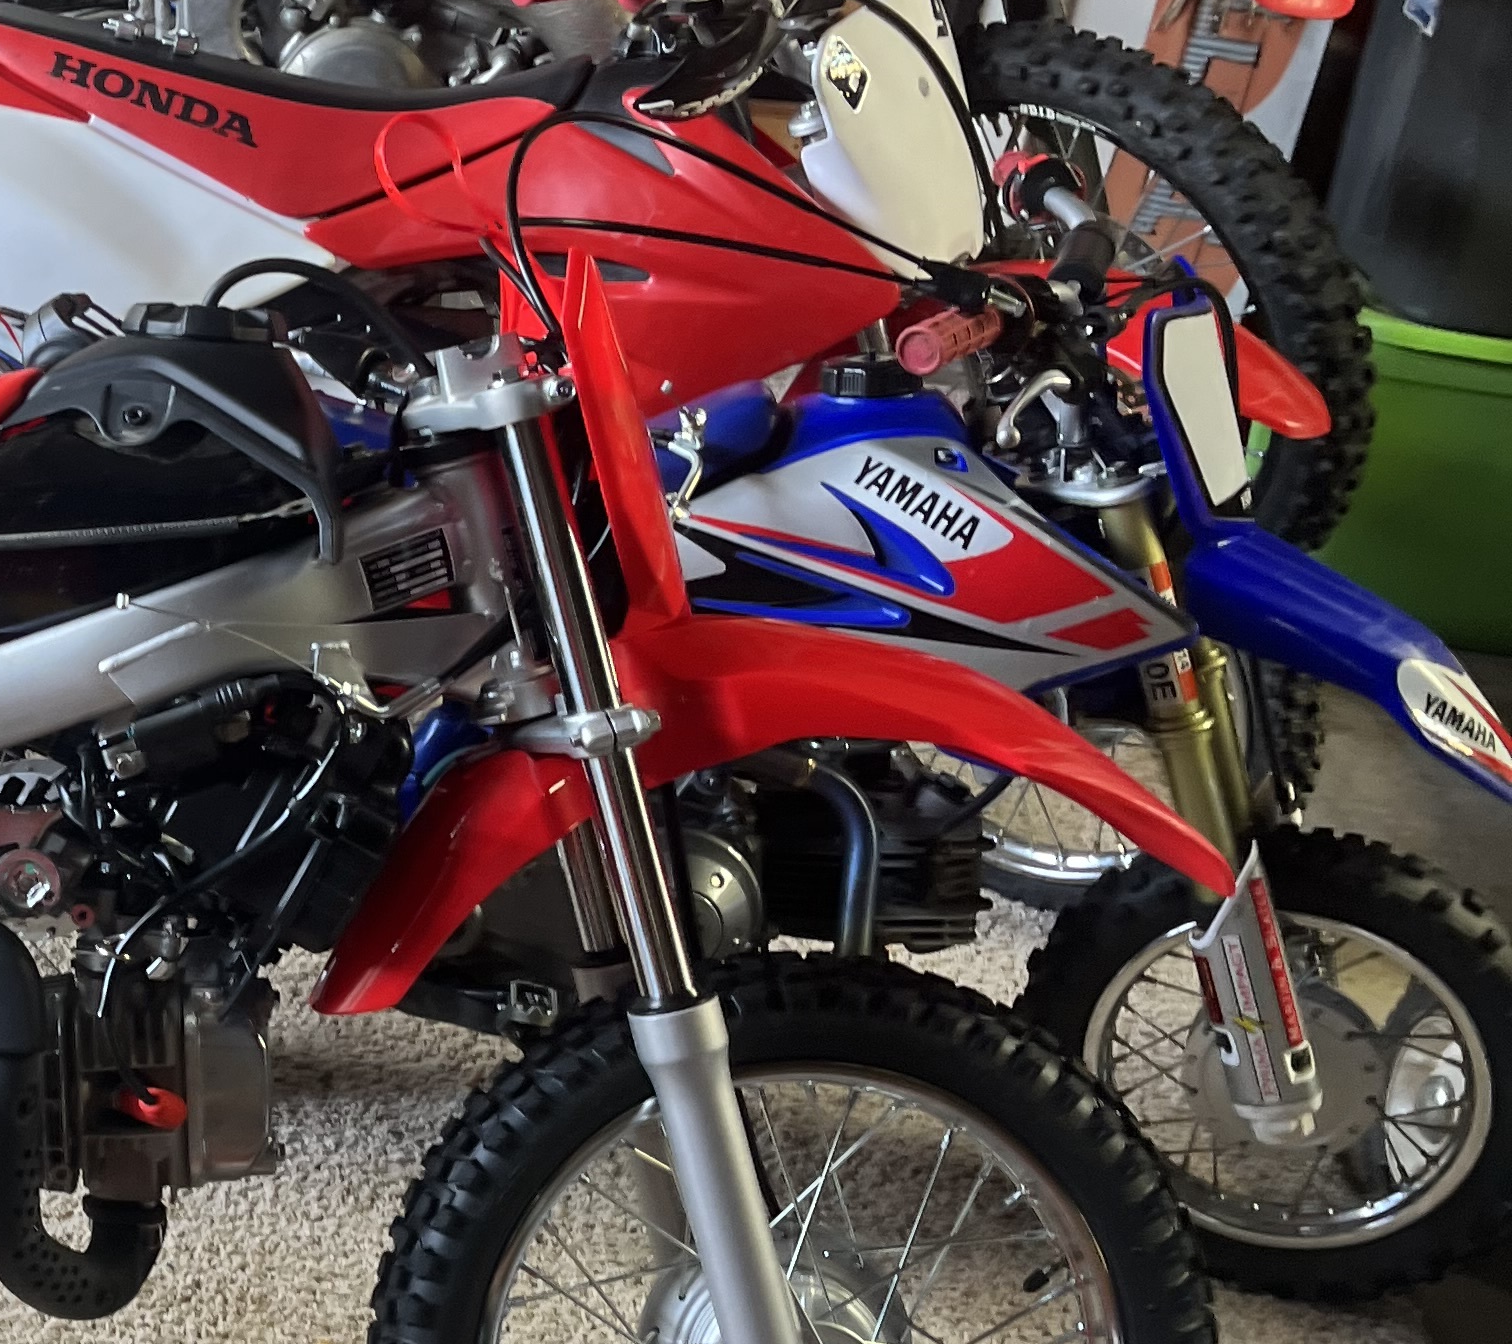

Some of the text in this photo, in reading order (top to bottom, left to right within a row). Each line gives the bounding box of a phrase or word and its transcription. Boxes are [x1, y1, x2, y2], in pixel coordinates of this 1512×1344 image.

[49, 51, 258, 149] HONDA
[854, 455, 981, 552] YAMAHA
[1424, 692, 1497, 754] YAMAHA
